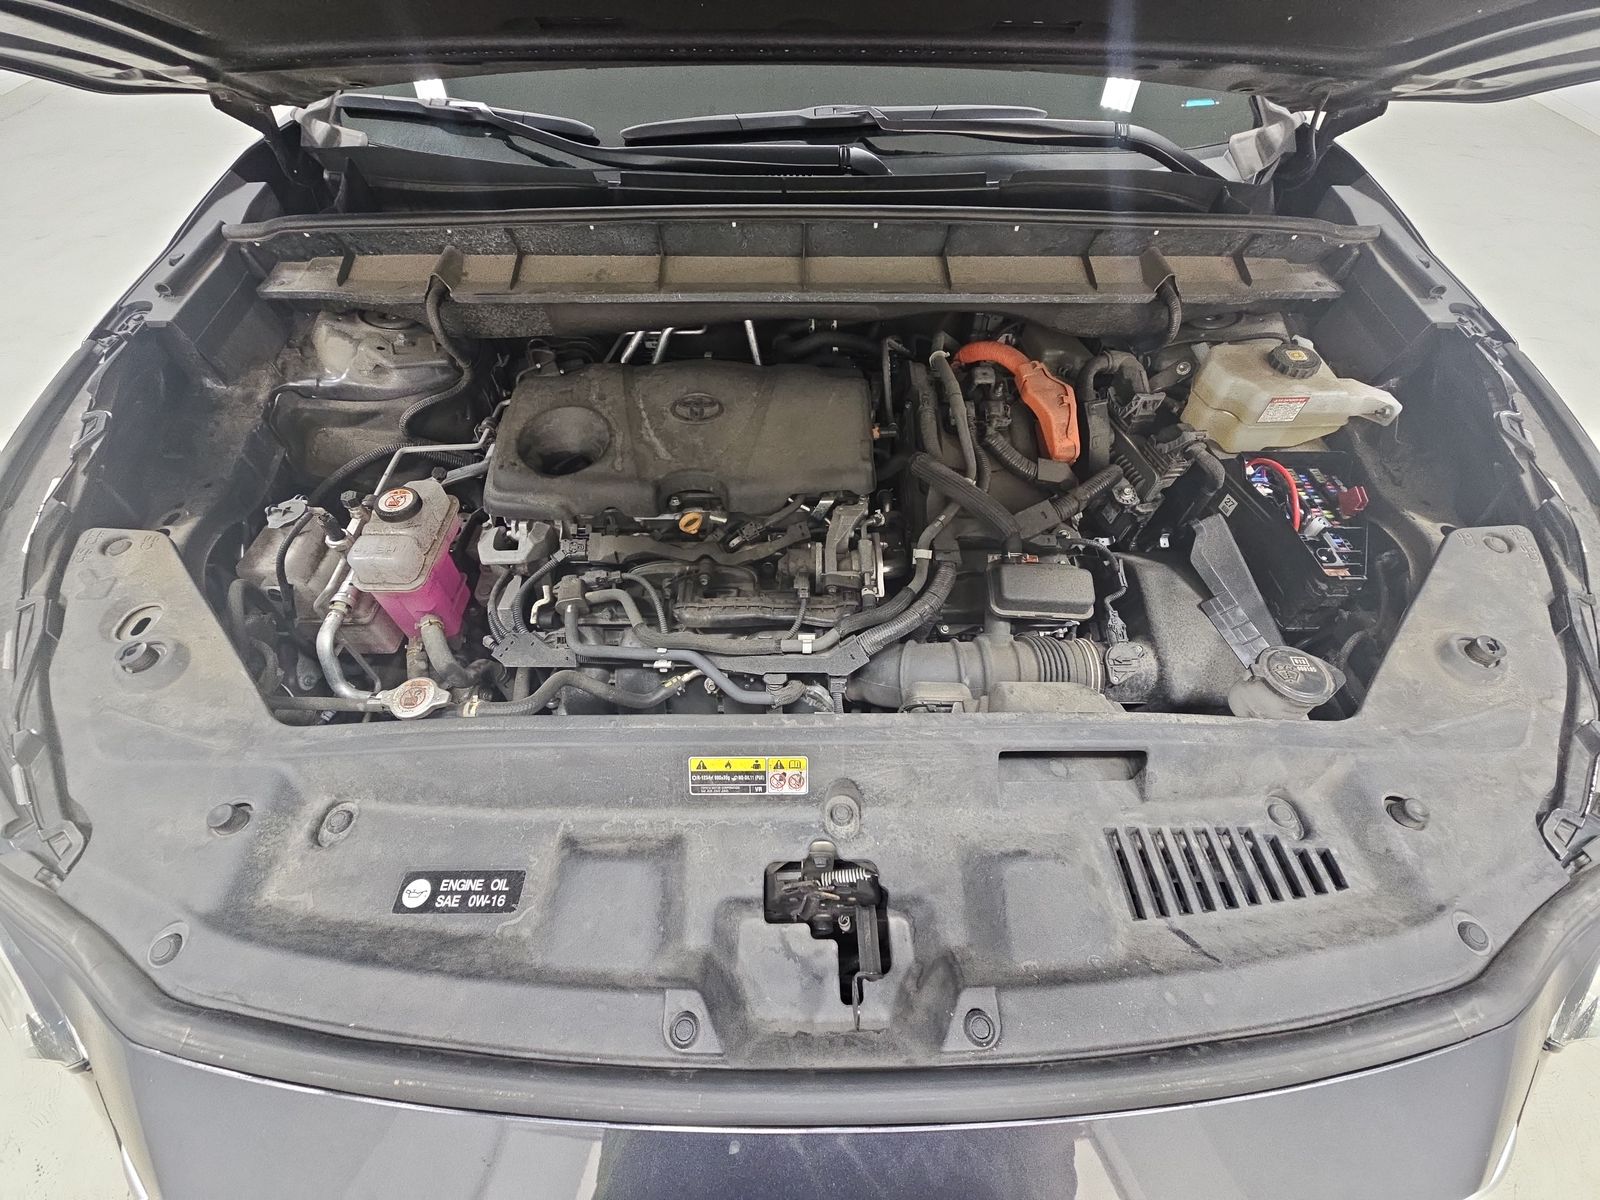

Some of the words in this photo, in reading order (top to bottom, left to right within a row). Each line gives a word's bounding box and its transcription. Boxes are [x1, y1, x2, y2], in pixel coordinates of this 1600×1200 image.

[1224, 497, 1235, 508] 27
[439, 879, 484, 891] ENGINE
[491, 878, 509, 891] OIL
[435, 895, 461, 907] SAE
[468, 895, 506, 907] 0W-16
